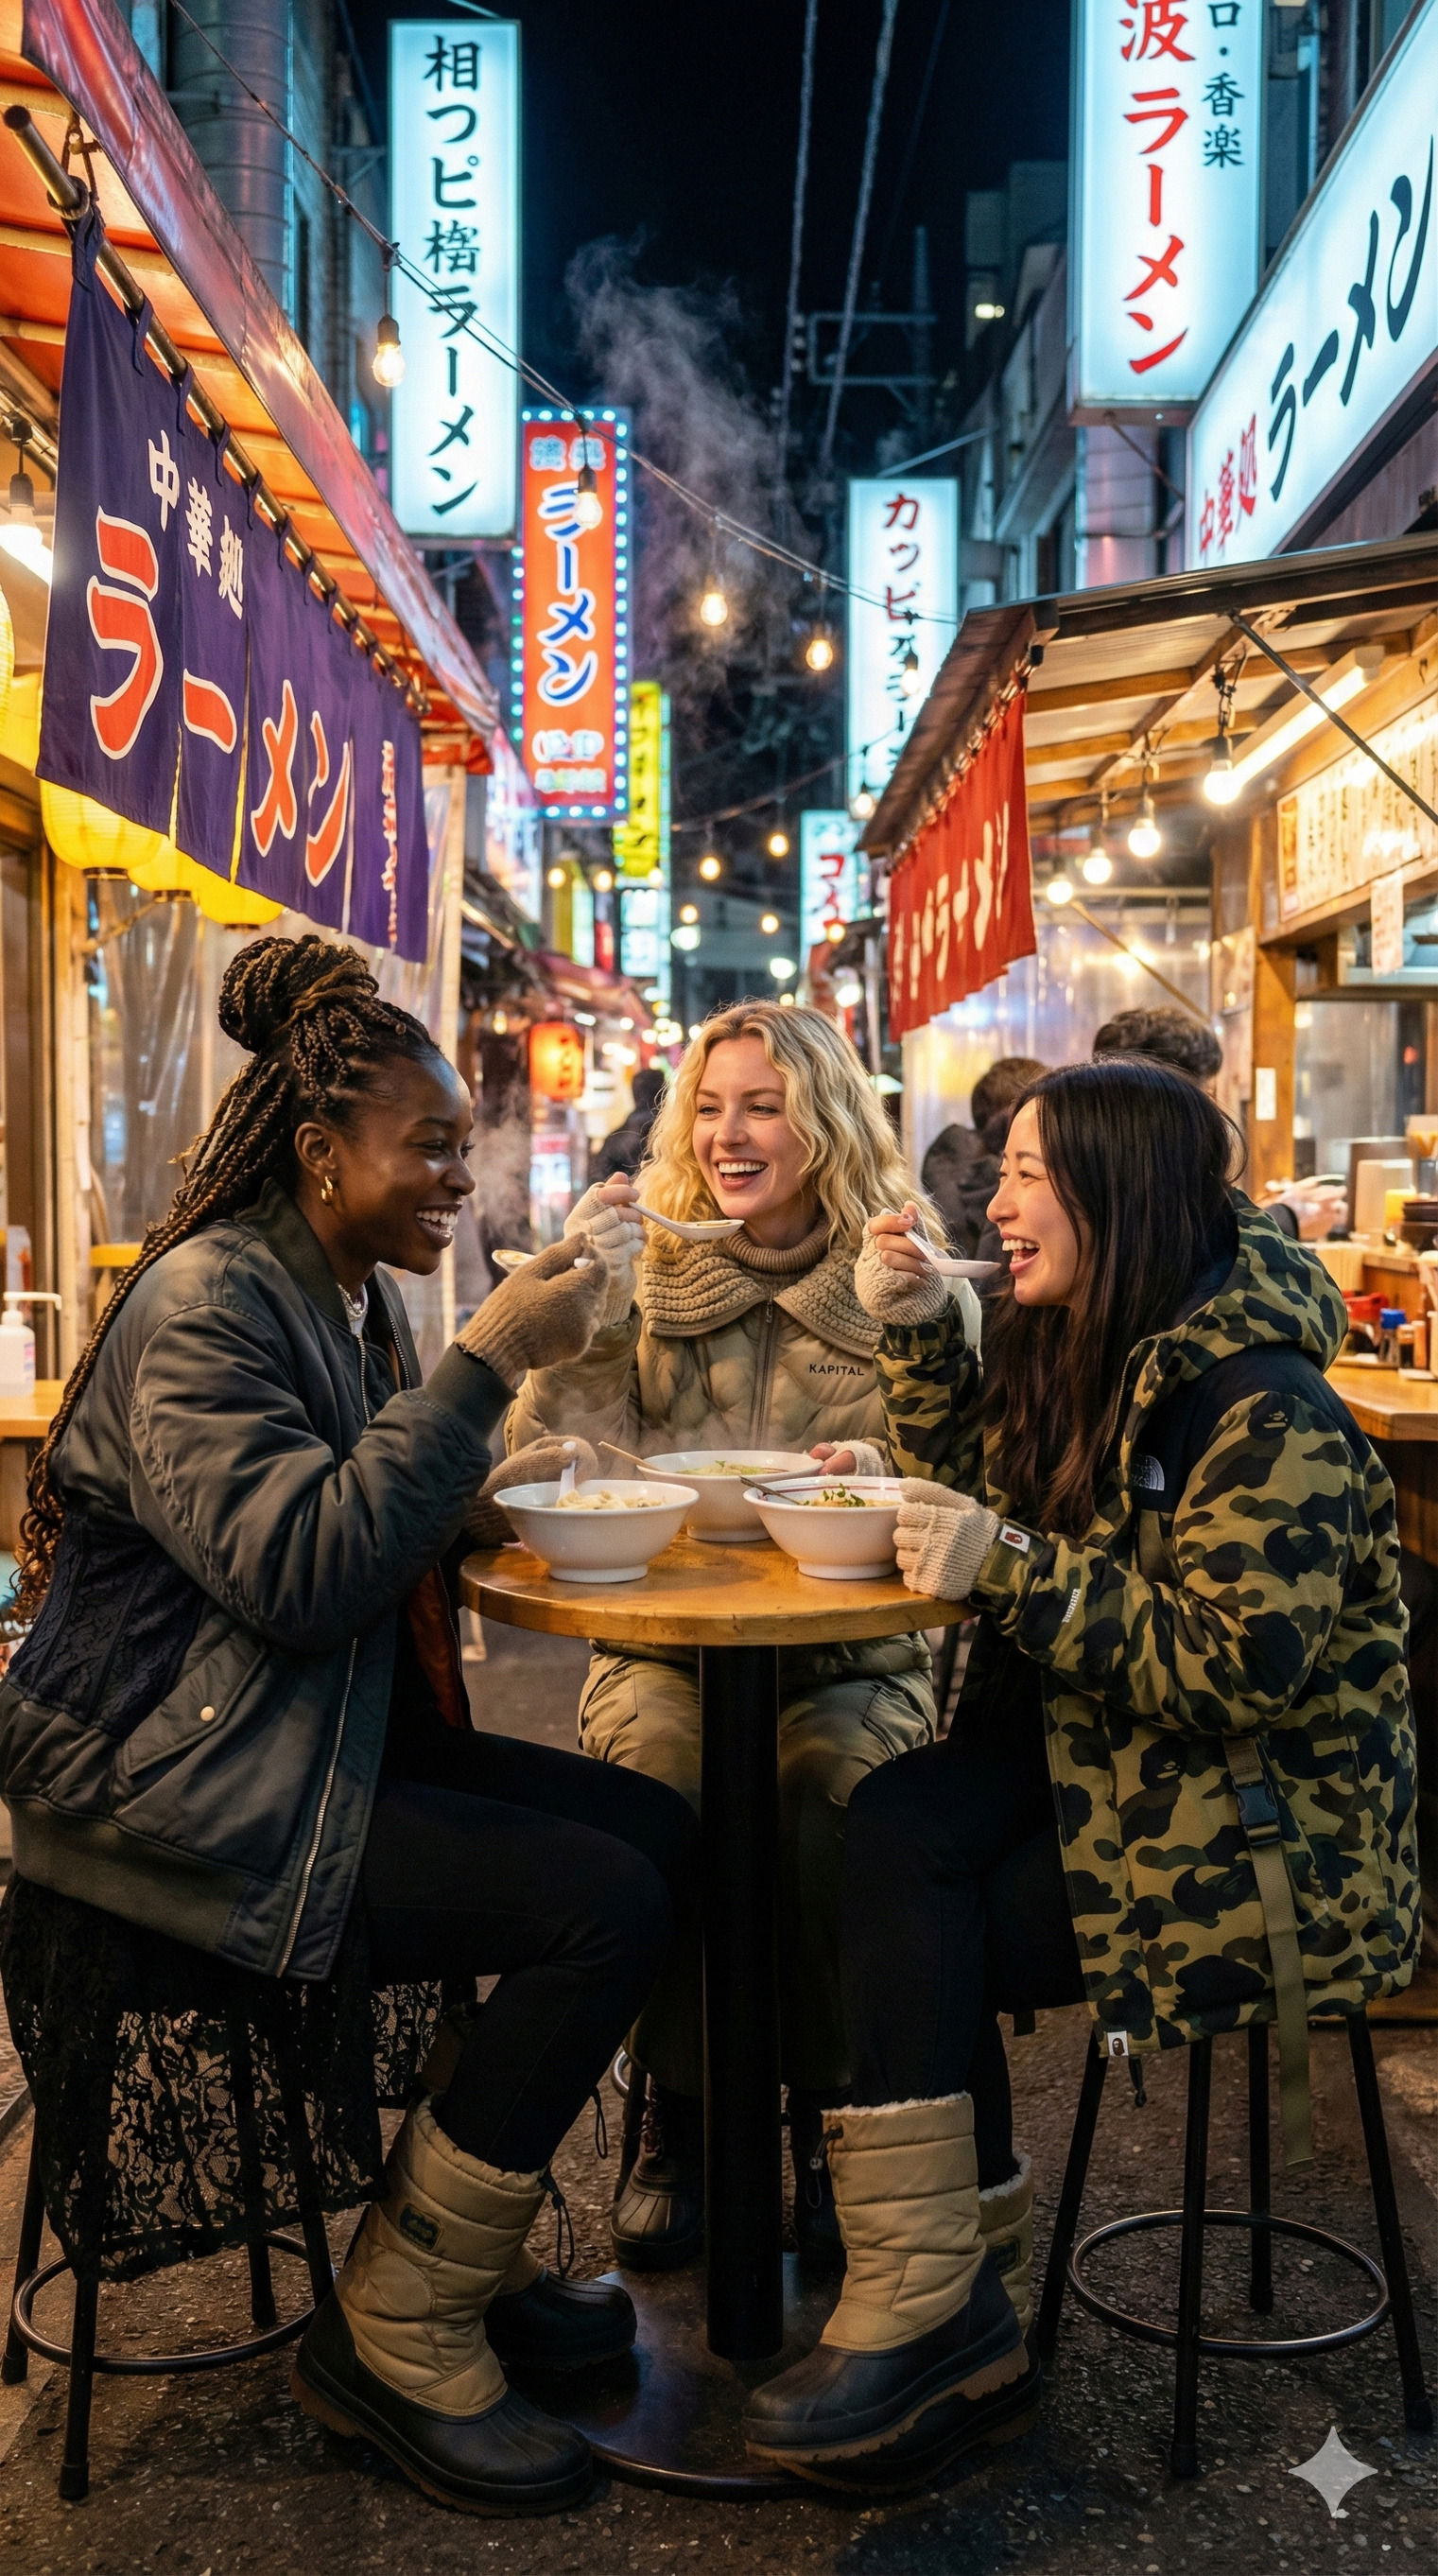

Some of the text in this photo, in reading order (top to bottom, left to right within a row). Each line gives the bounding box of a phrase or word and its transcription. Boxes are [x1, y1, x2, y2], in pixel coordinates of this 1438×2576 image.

[1269, 133, 1434, 501] ラーメン
[86, 505, 352, 887] ラーメン
[537, 480, 598, 706] ラーメン
[808, 1363, 865, 1376] KAPITAL
